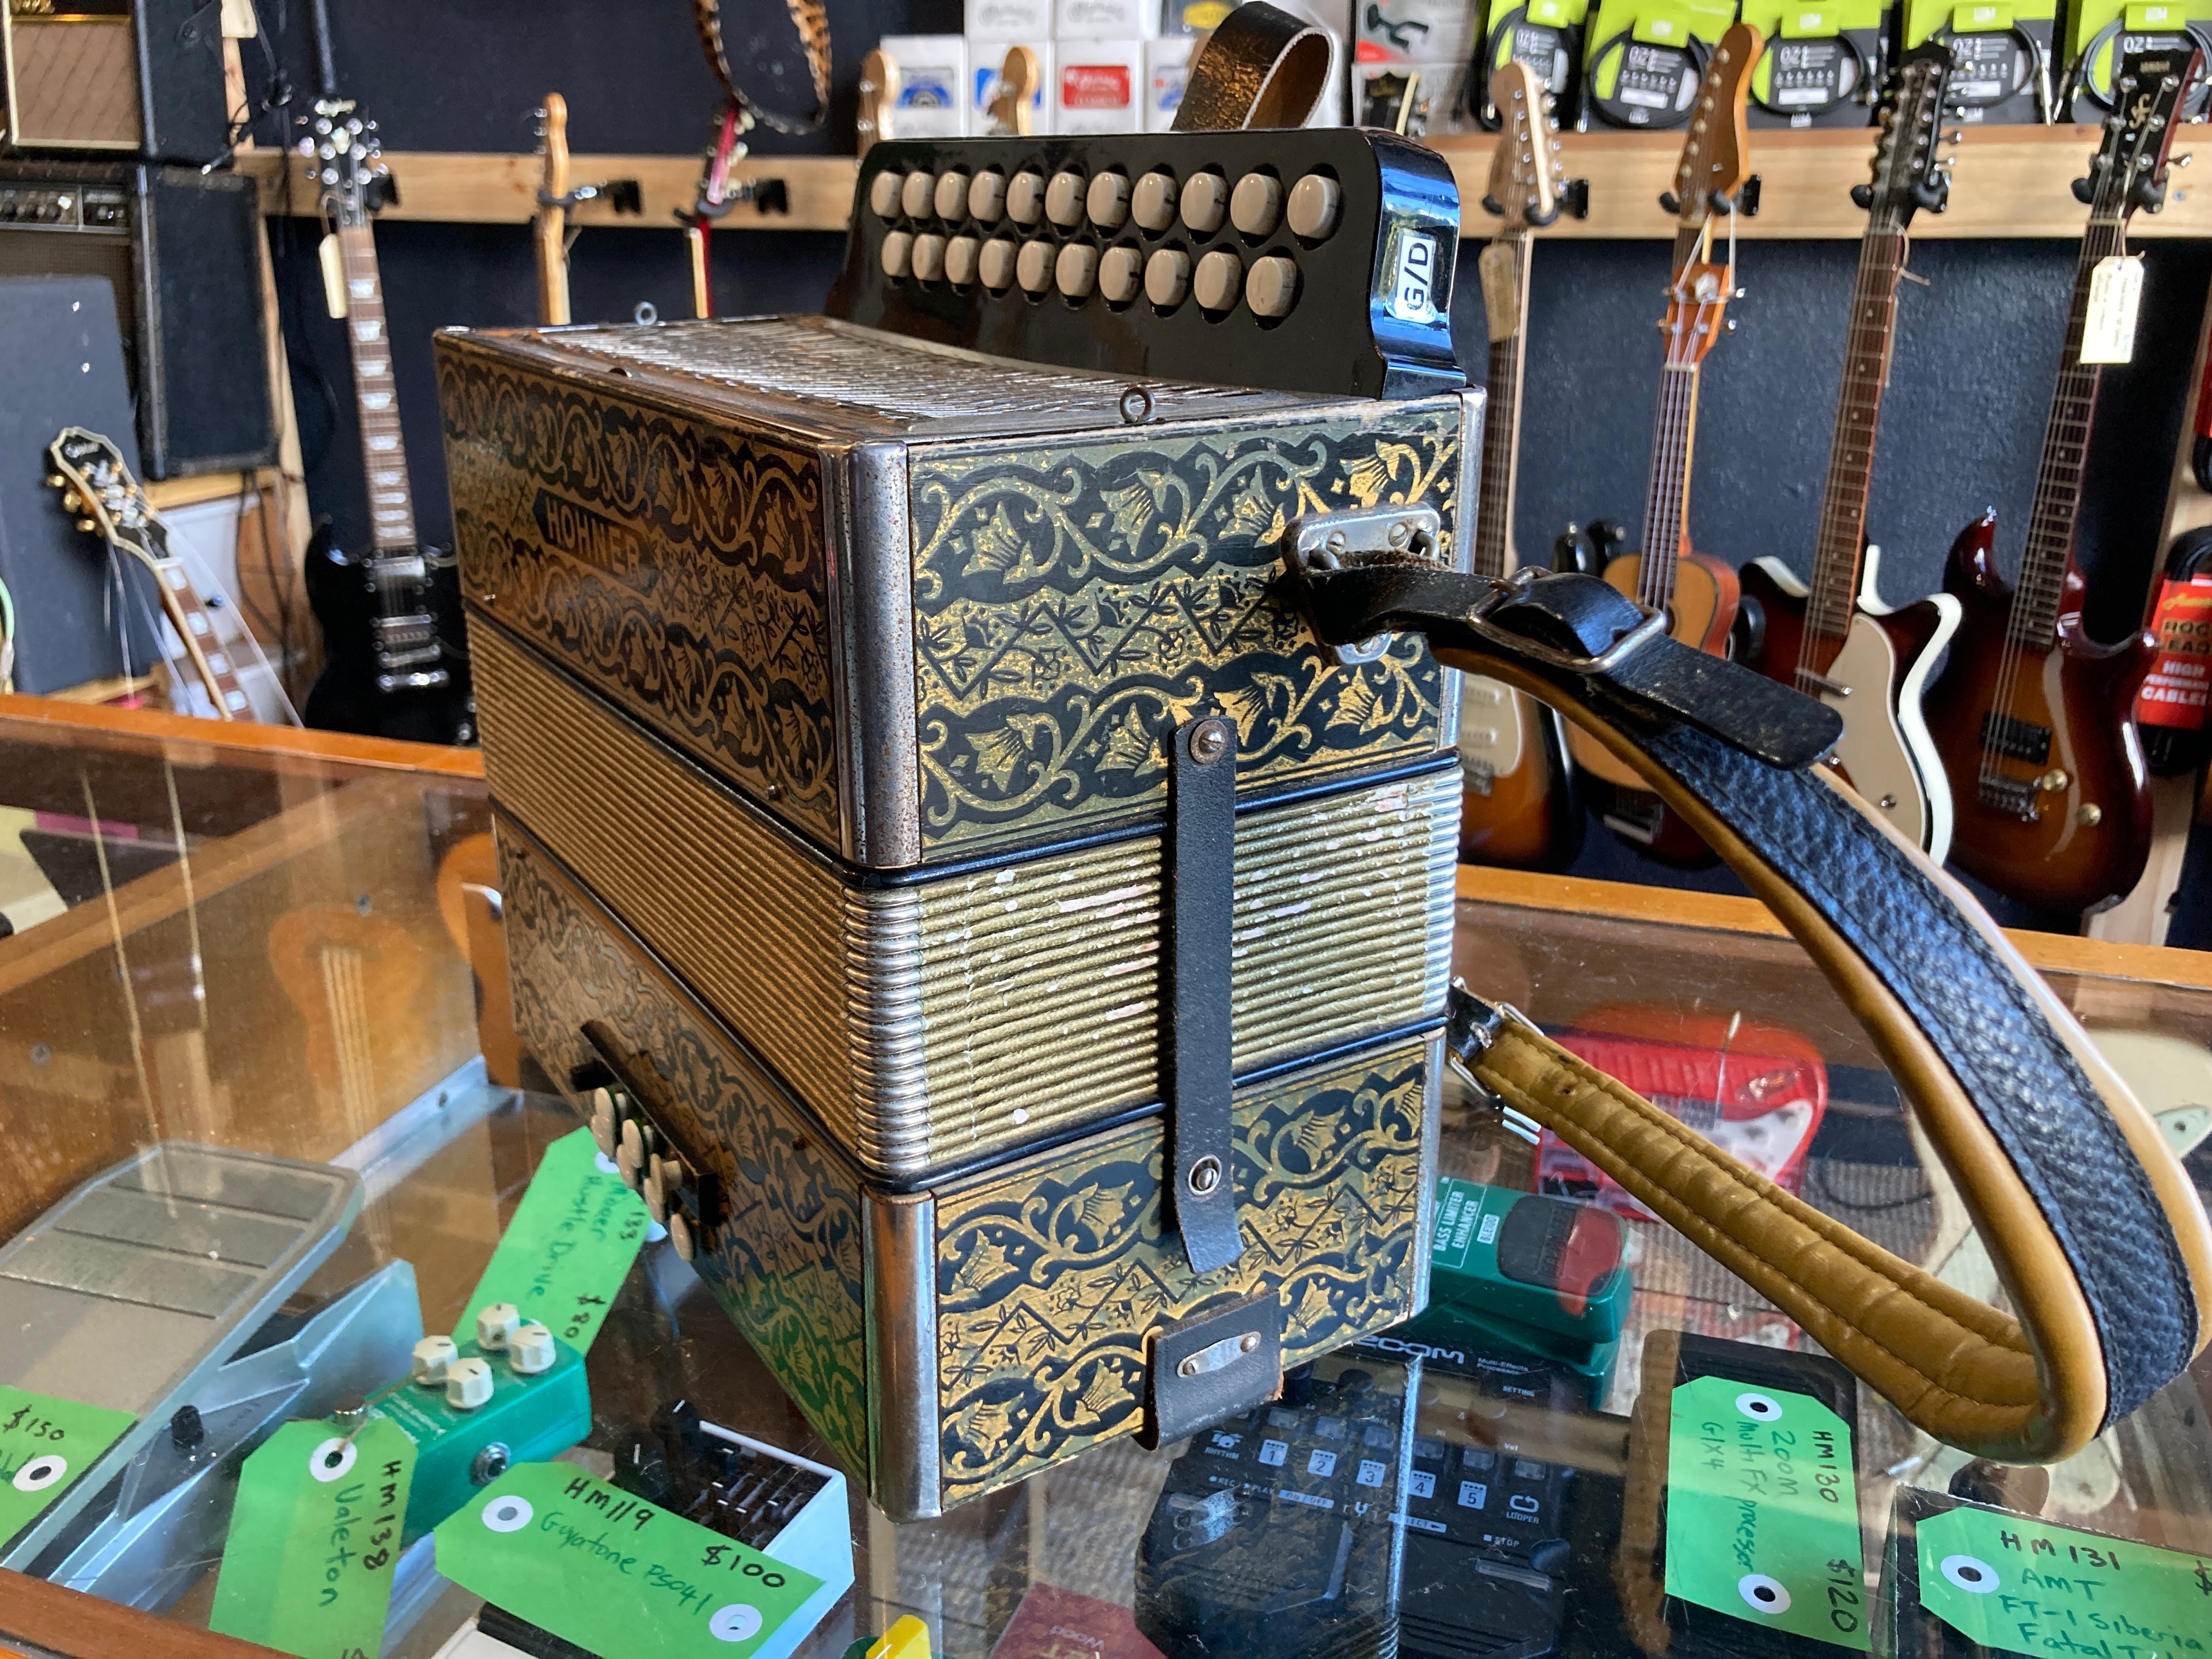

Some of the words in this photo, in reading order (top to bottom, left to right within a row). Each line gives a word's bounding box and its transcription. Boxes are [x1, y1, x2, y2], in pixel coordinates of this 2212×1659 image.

[1404, 242, 1429, 310] G/D
[546, 497, 643, 584] HOHNER
[2163, 661, 2205, 677] HIGH
[1441, 1191, 1464, 1226] LIMITER
[1433, 1227, 1452, 1251] BASS
[1452, 1200, 1478, 1249] ENHANCER
[564, 1292, 607, 1339] $80
[3, 1404, 65, 1441] $150
[1268, 1450, 1275, 1461] 1
[1316, 1460, 1325, 1472] 2
[1365, 1471, 1376, 1482] 3
[1415, 1482, 1426, 1494] 4
[1467, 1493, 1477, 1505] 5
[1506, 1512, 1539, 1524] LOOPER
[1495, 1536, 1520, 1547] STOP
[701, 1544, 786, 1589] $100
[1825, 1558, 1859, 1633] $120
[2022, 1567, 2105, 1602] AMT
